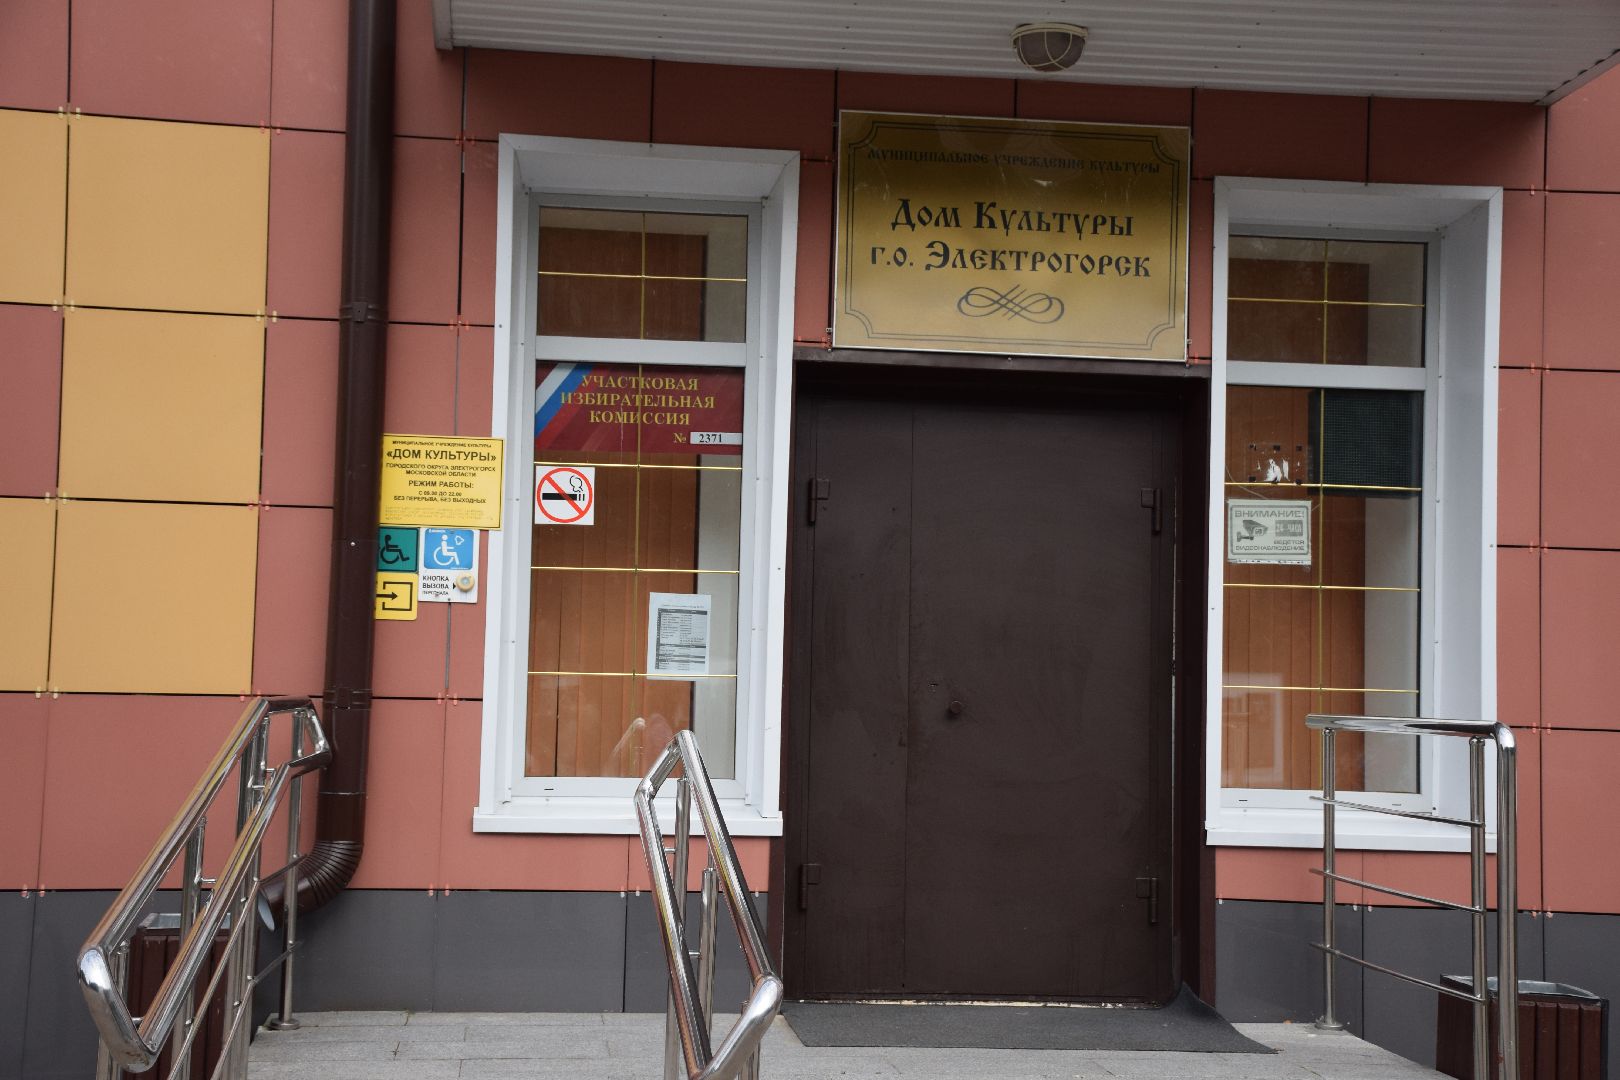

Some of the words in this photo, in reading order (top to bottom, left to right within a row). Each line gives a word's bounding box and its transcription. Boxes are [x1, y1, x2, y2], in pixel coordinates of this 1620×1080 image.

[582, 375, 698, 391] УЧАСТКОВАЯ
[561, 392, 714, 408] ИЗБИРАТЕЛЬНАЯ
[590, 410, 690, 425] КОМИССИЯ
[699, 433, 722, 443] 2371
[387, 449, 421, 459] «ДОМ
[426, 450, 496, 462] КУЛЬТУРЫ»
[1235, 510, 1304, 518] ВНИМАНИЕ!
